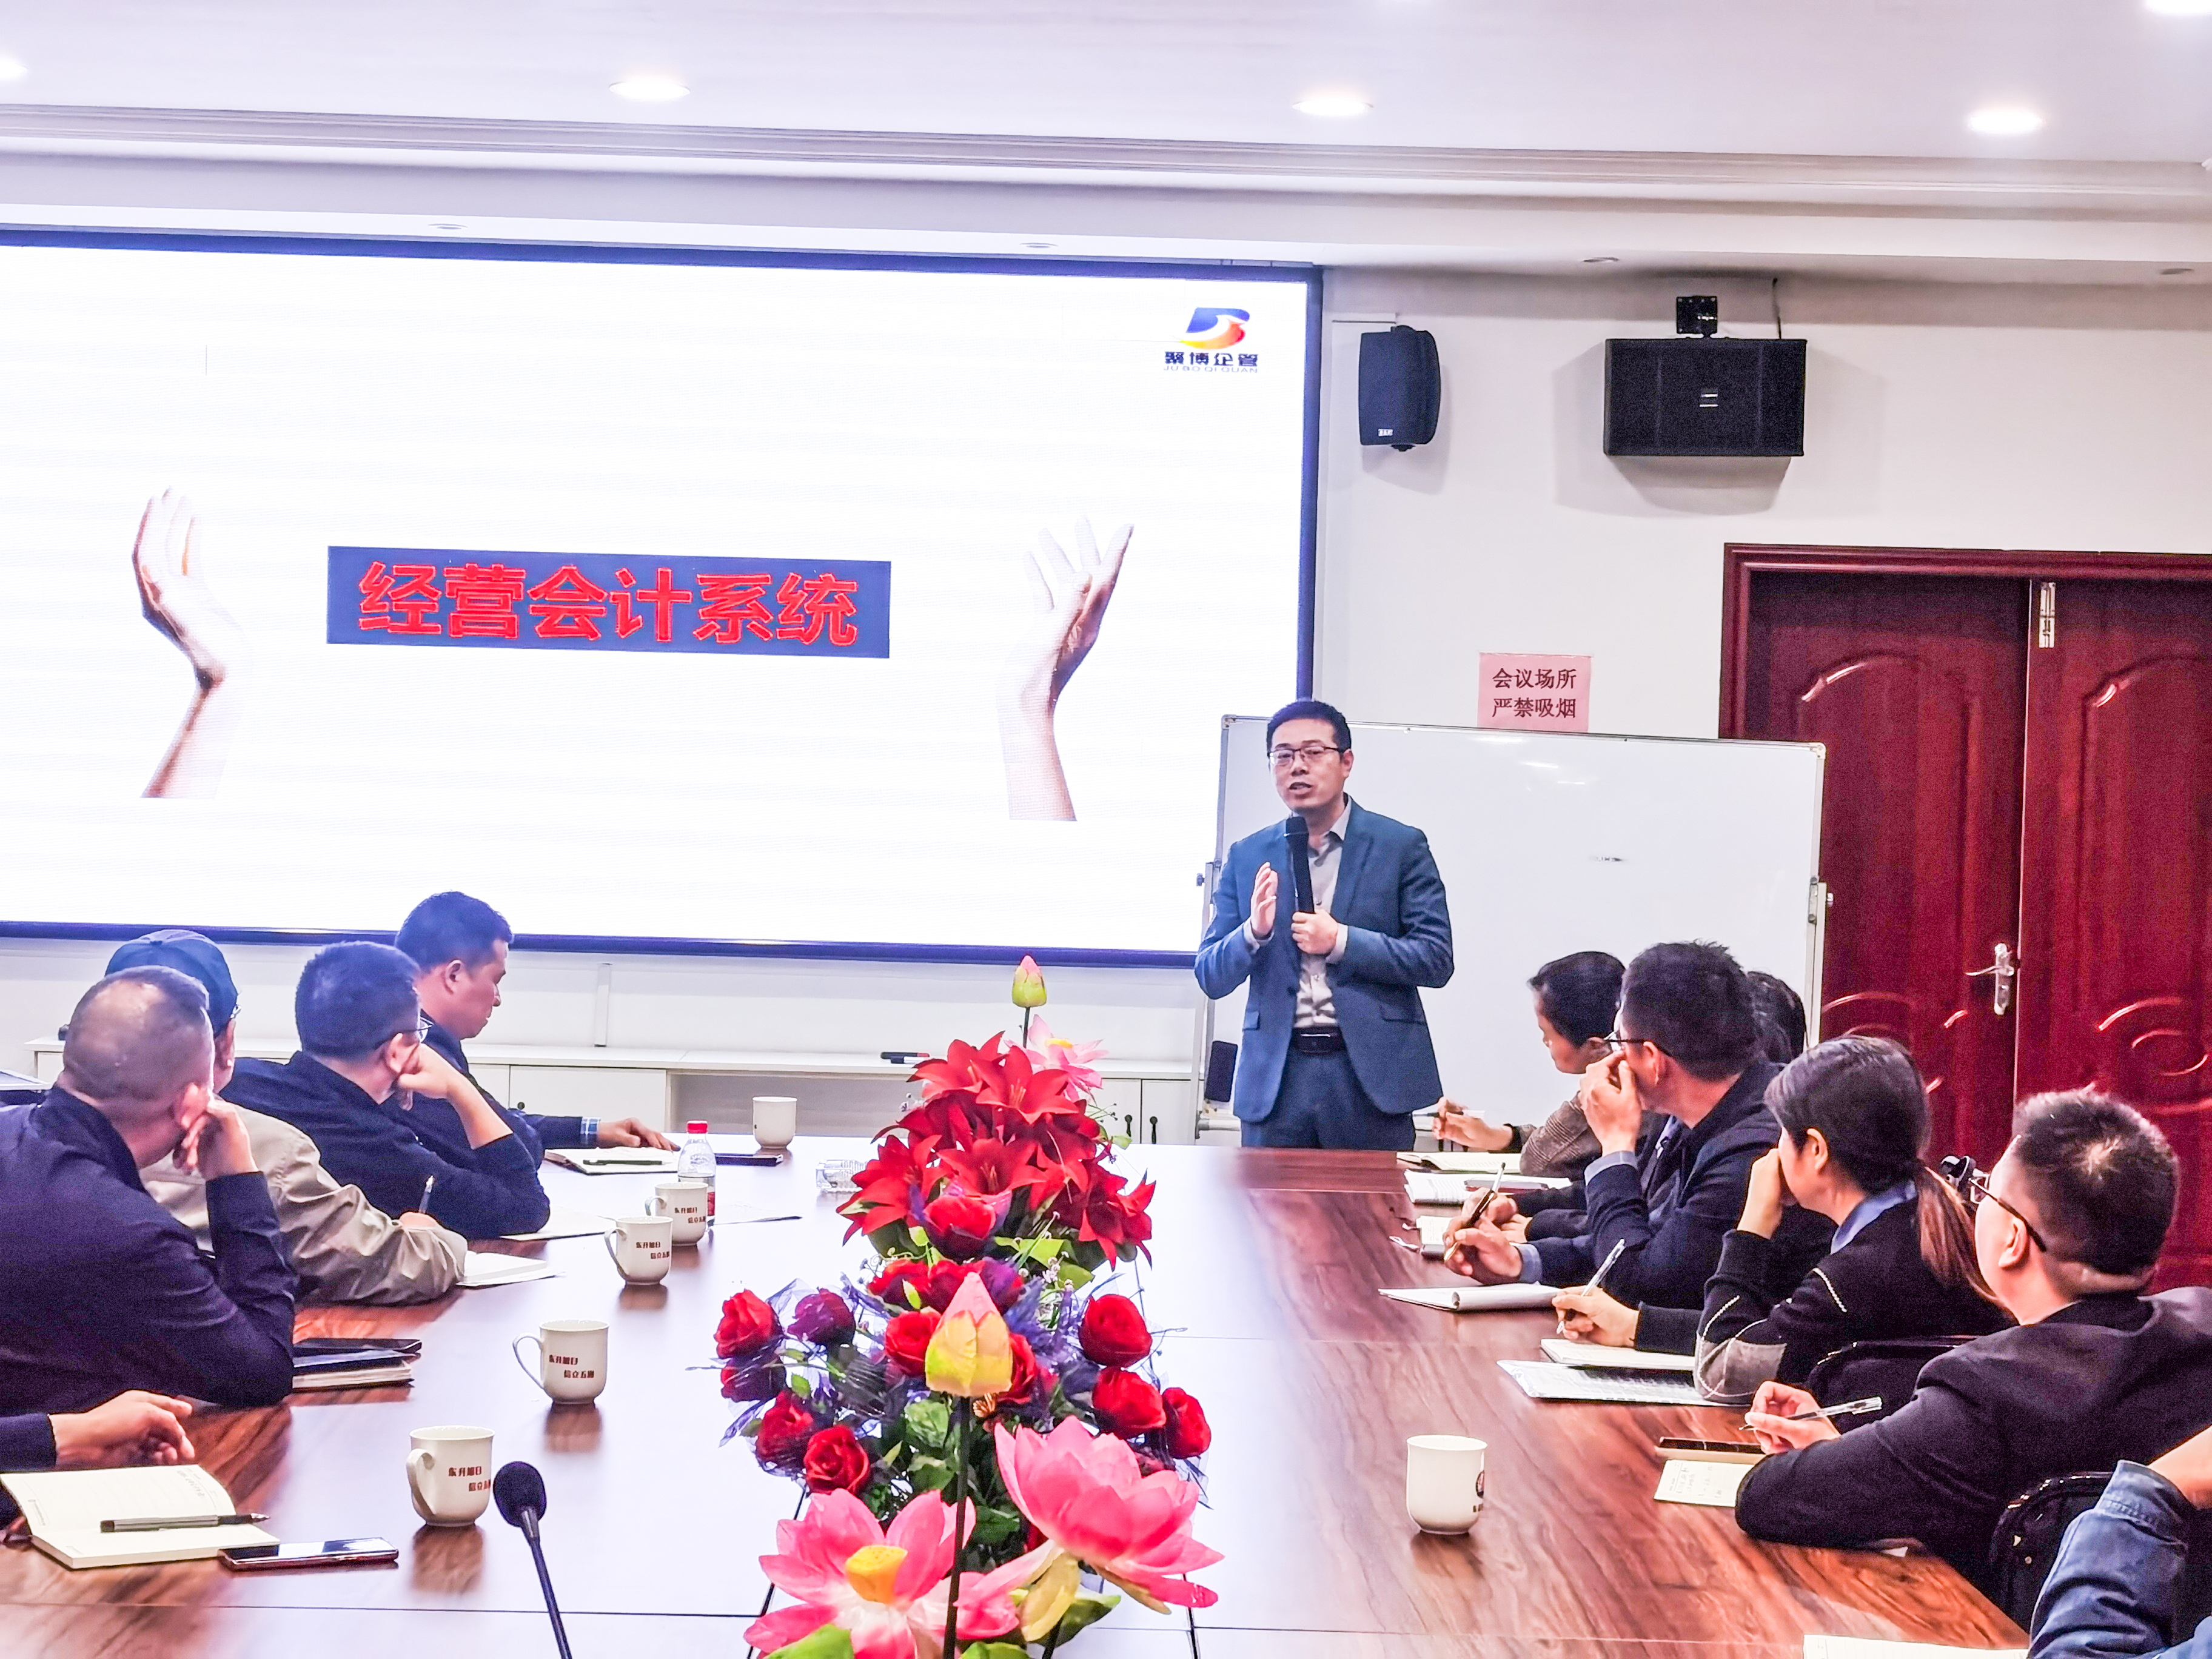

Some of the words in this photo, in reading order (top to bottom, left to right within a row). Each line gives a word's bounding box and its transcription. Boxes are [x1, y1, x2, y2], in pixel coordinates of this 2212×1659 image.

[1164, 350, 1259, 367] 聚博企管
[359, 561, 857, 646] 经营会计系统
[1492, 668, 1577, 689] 会议场所
[1492, 697, 1577, 719] 严禁吸烟
